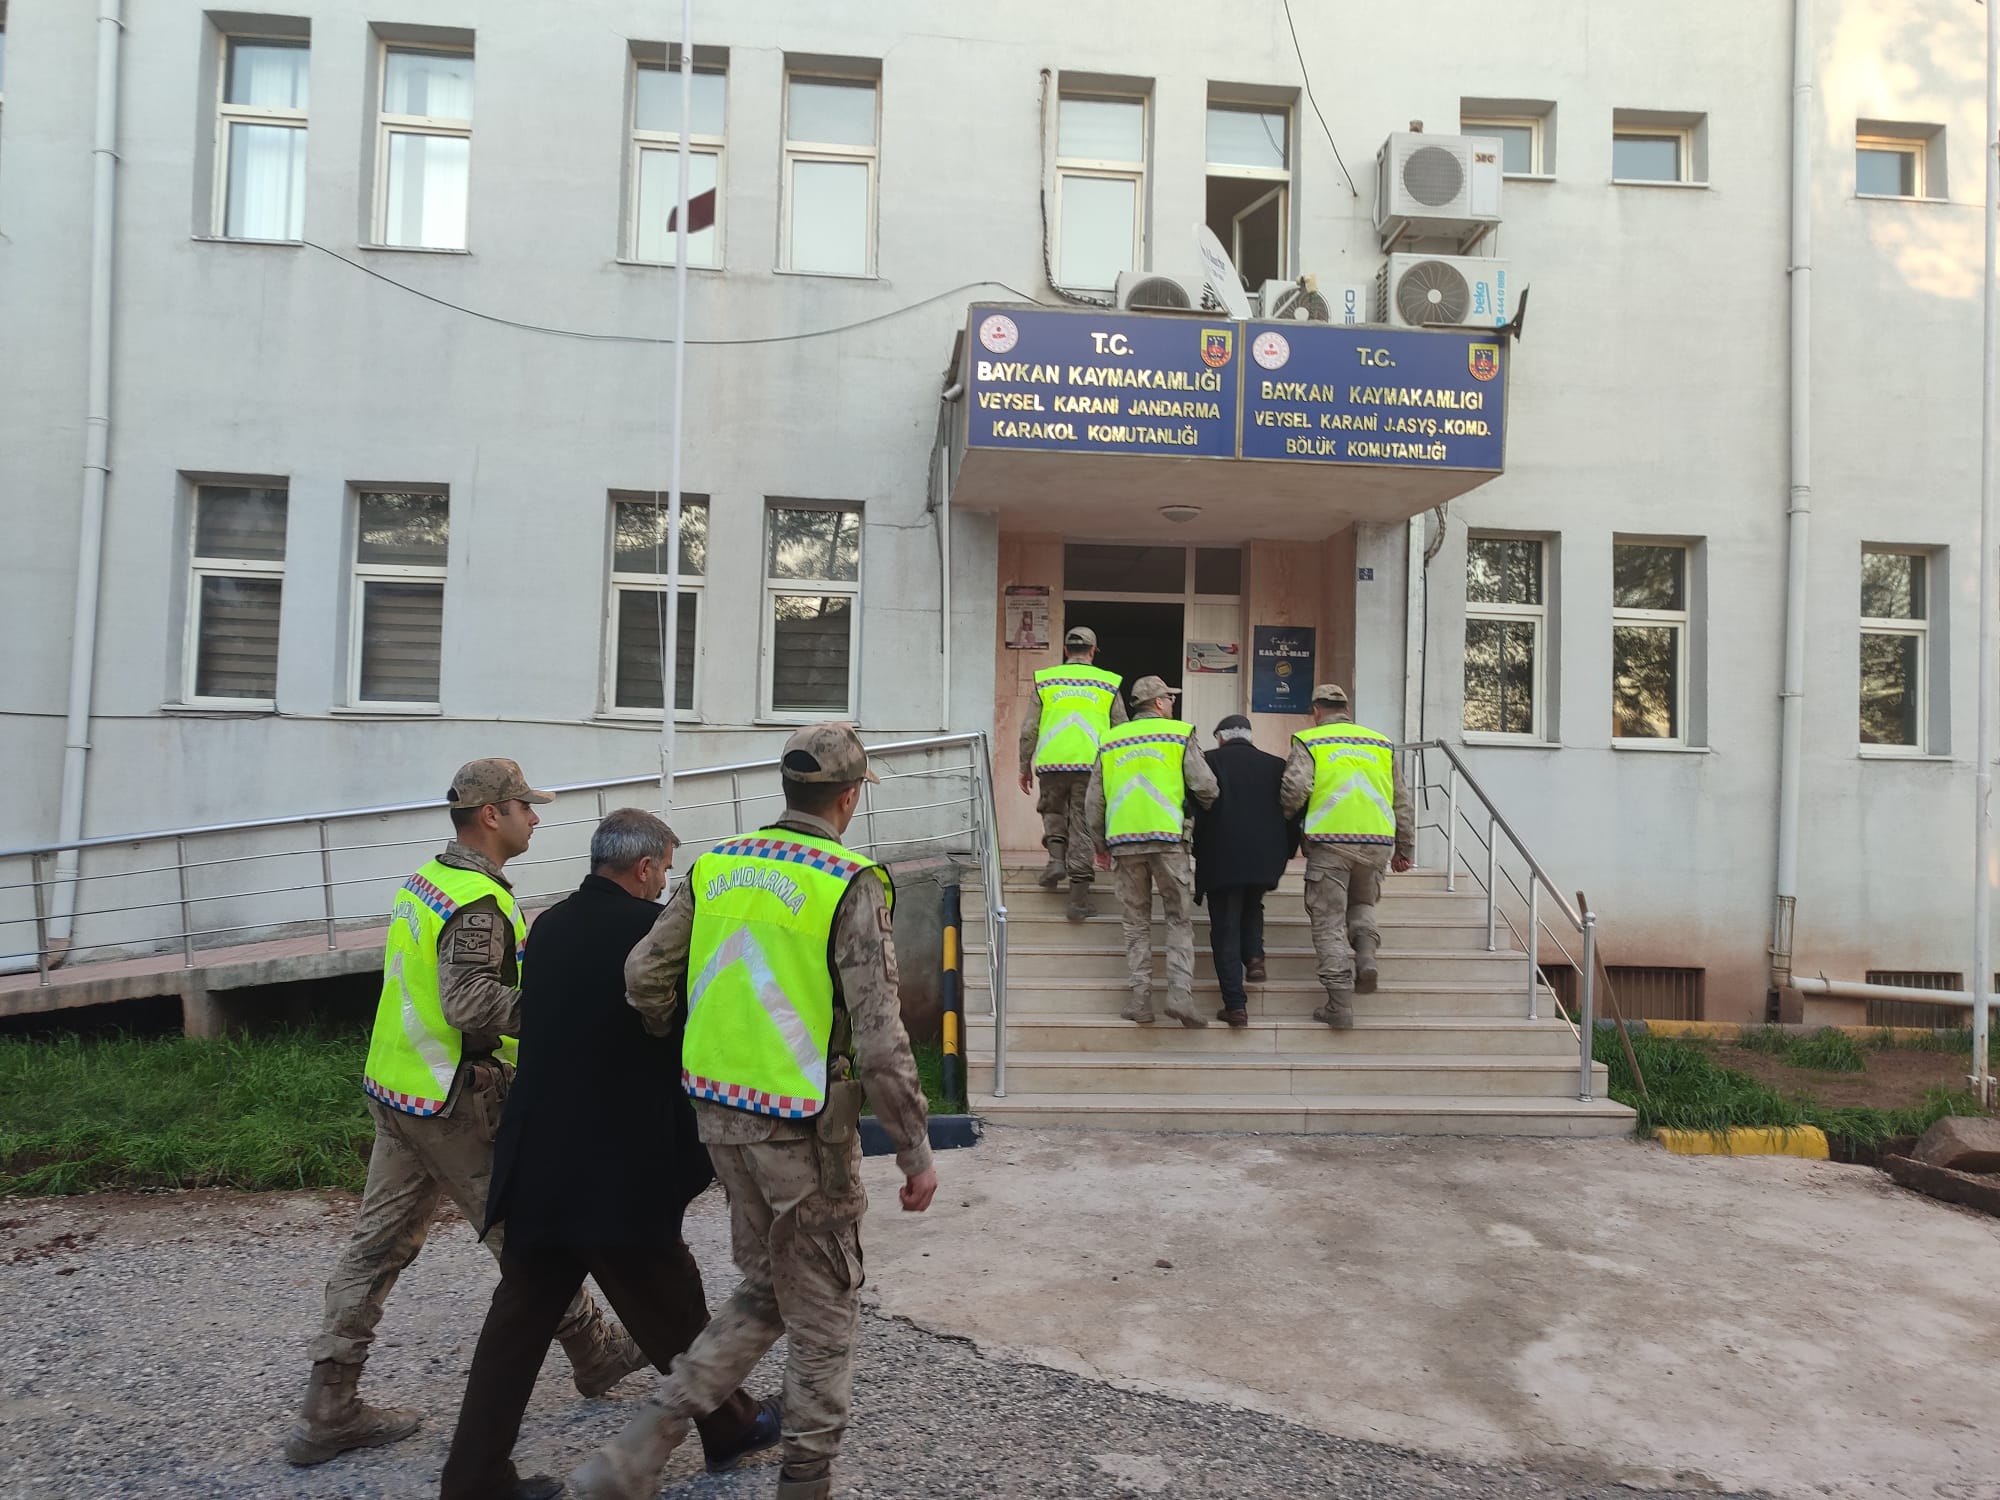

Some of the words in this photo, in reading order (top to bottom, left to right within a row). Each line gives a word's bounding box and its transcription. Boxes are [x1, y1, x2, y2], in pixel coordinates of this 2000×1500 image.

[1345, 290, 1355, 325] EKO
[1473, 282, 1485, 314] beko
[1090, 332, 1135, 355] T.C.
[1356, 347, 1396, 367] T.C.
[977, 361, 1060, 385] BAYKAN
[1068, 365, 1222, 392] KAYMAKAMLIĞI
[1261, 381, 1334, 403] BAYKAN
[978, 391, 1045, 412] VEYSEL
[1128, 399, 1221, 420] JANDARMA
[992, 420, 1078, 441] KARAKOL
[1088, 424, 1198, 446] KOMUTANLIĞI
[1254, 410, 1312, 429] VEYSEL
[1320, 412, 1378, 432] KARANİ
[1286, 436, 1337, 456] BÖLÜK
[1348, 440, 1447, 461] KOMUTANLIĞI
[1052, 689, 1099, 704] JANDARMA
[1328, 748, 1377, 764] JANDARMA
[706, 867, 807, 916] JANDARMA
